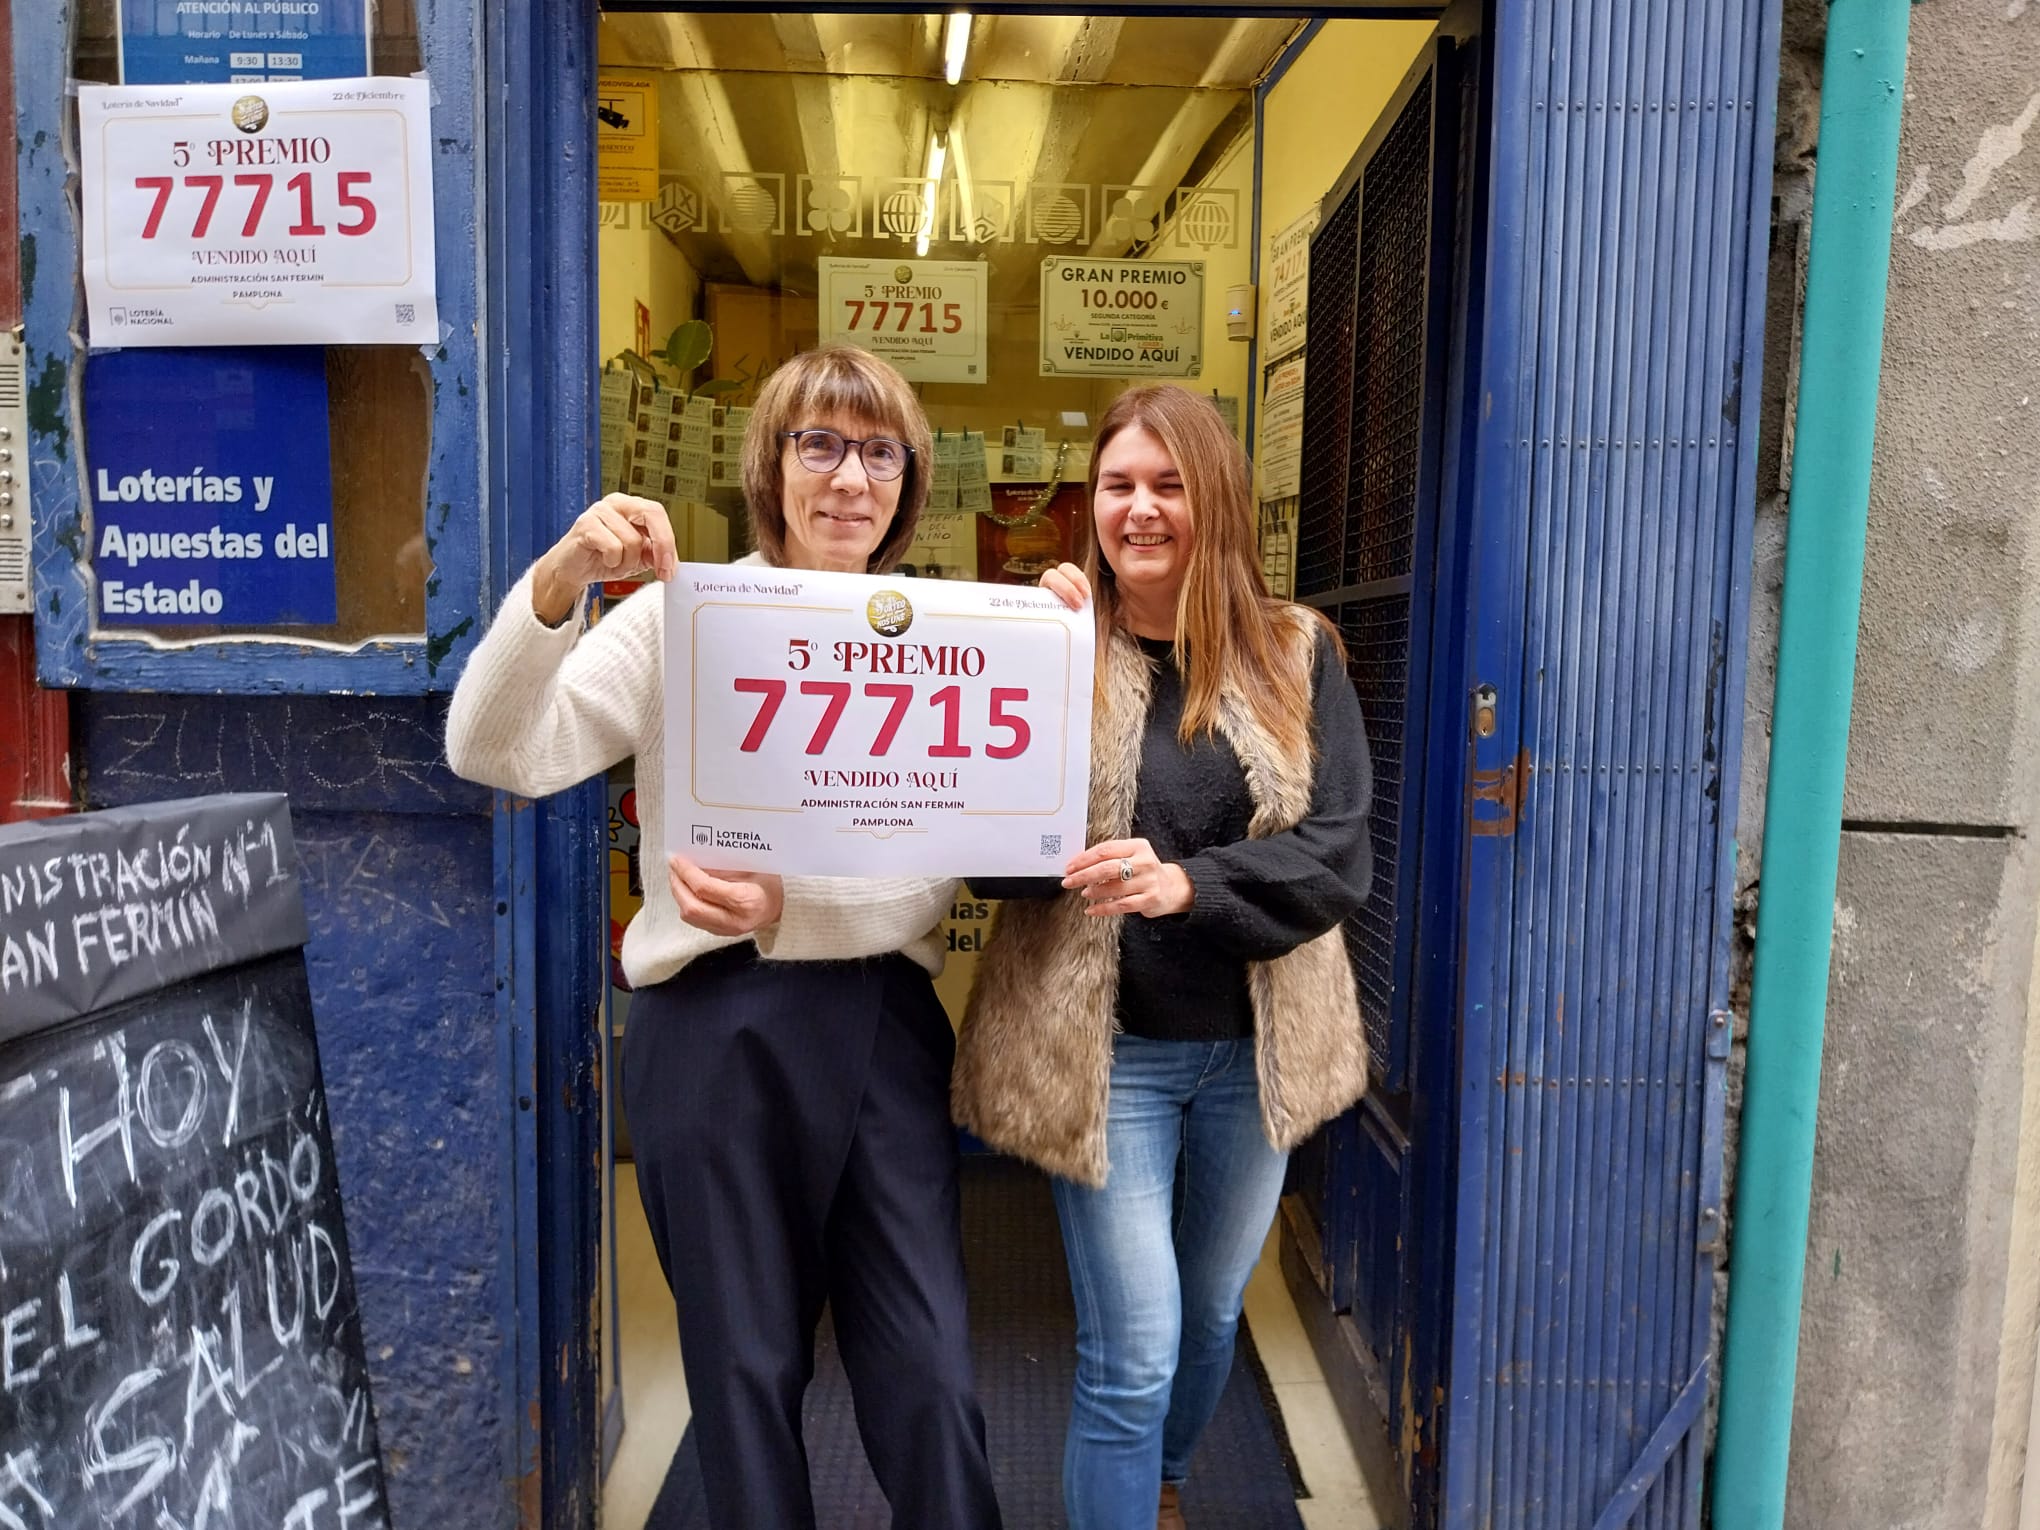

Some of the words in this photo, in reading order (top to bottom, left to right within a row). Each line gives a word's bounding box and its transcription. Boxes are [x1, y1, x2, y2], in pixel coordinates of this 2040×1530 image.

[176, 0, 241, 14] ATENCIÓN
[244, 2, 260, 15] AL
[263, 0, 319, 15] PÚBLICO
[188, 30, 221, 39] Horario
[229, 30, 241, 39] De
[243, 30, 267, 39] Lunes
[276, 30, 308, 40] Sábado
[184, 54, 220, 65] Mañana
[236, 56, 258, 66] 9:30
[271, 56, 299, 66] 13:30
[332, 92, 345, 101] 22
[346, 92, 355, 101] de
[356, 91, 406, 101] Diciembre
[134, 100, 145, 108] de
[207, 136, 331, 166] PREMIO
[135, 171, 378, 239] 77715
[191, 249, 268, 265] VENDIDO
[273, 245, 317, 267] AQUÍ
[191, 273, 268, 284] ADMINISTRACIÓN
[270, 274, 289, 283] SAN
[290, 273, 324, 282] FERMIN
[1061, 267, 1114, 283] GRAN
[1120, 270, 1187, 285] PREMIO
[232, 290, 282, 299] PAMPLONA
[881, 285, 942, 300] PREMIO
[129, 309, 164, 318] LOTERÍA
[845, 300, 963, 334] 77715
[130, 317, 174, 326] NACIONAL
[872, 336, 910, 345] VENDIDO
[912, 336, 933, 347] AQUÍ
[1100, 332, 1110, 340] La
[1127, 332, 1164, 342] Primitiva
[1064, 346, 1134, 361] VENDIDO
[1139, 346, 1180, 362] AQUÍ
[97, 467, 243, 503] Loterías
[253, 476, 274, 512] y
[100, 525, 263, 566] Apuestas
[275, 523, 328, 558] del
[738, 582, 752, 594] de
[102, 580, 223, 614] Estado
[989, 597, 1001, 607] 22
[1002, 598, 1013, 608] de
[833, 641, 985, 677] PREMIO
[733, 677, 1032, 760] 77715
[804, 769, 899, 788] VENDIDO
[906, 768, 958, 792] AQUÍ
[800, 797, 898, 809] ADMINISTRACIÓN
[900, 800, 924, 809] SAN
[925, 800, 965, 809] FERMIN
[852, 818, 914, 827] PAMPLONA
[716, 829, 761, 841] LOTERÍA
[716, 839, 773, 851] NACIONAL
[58, 999, 252, 1208] HOY
